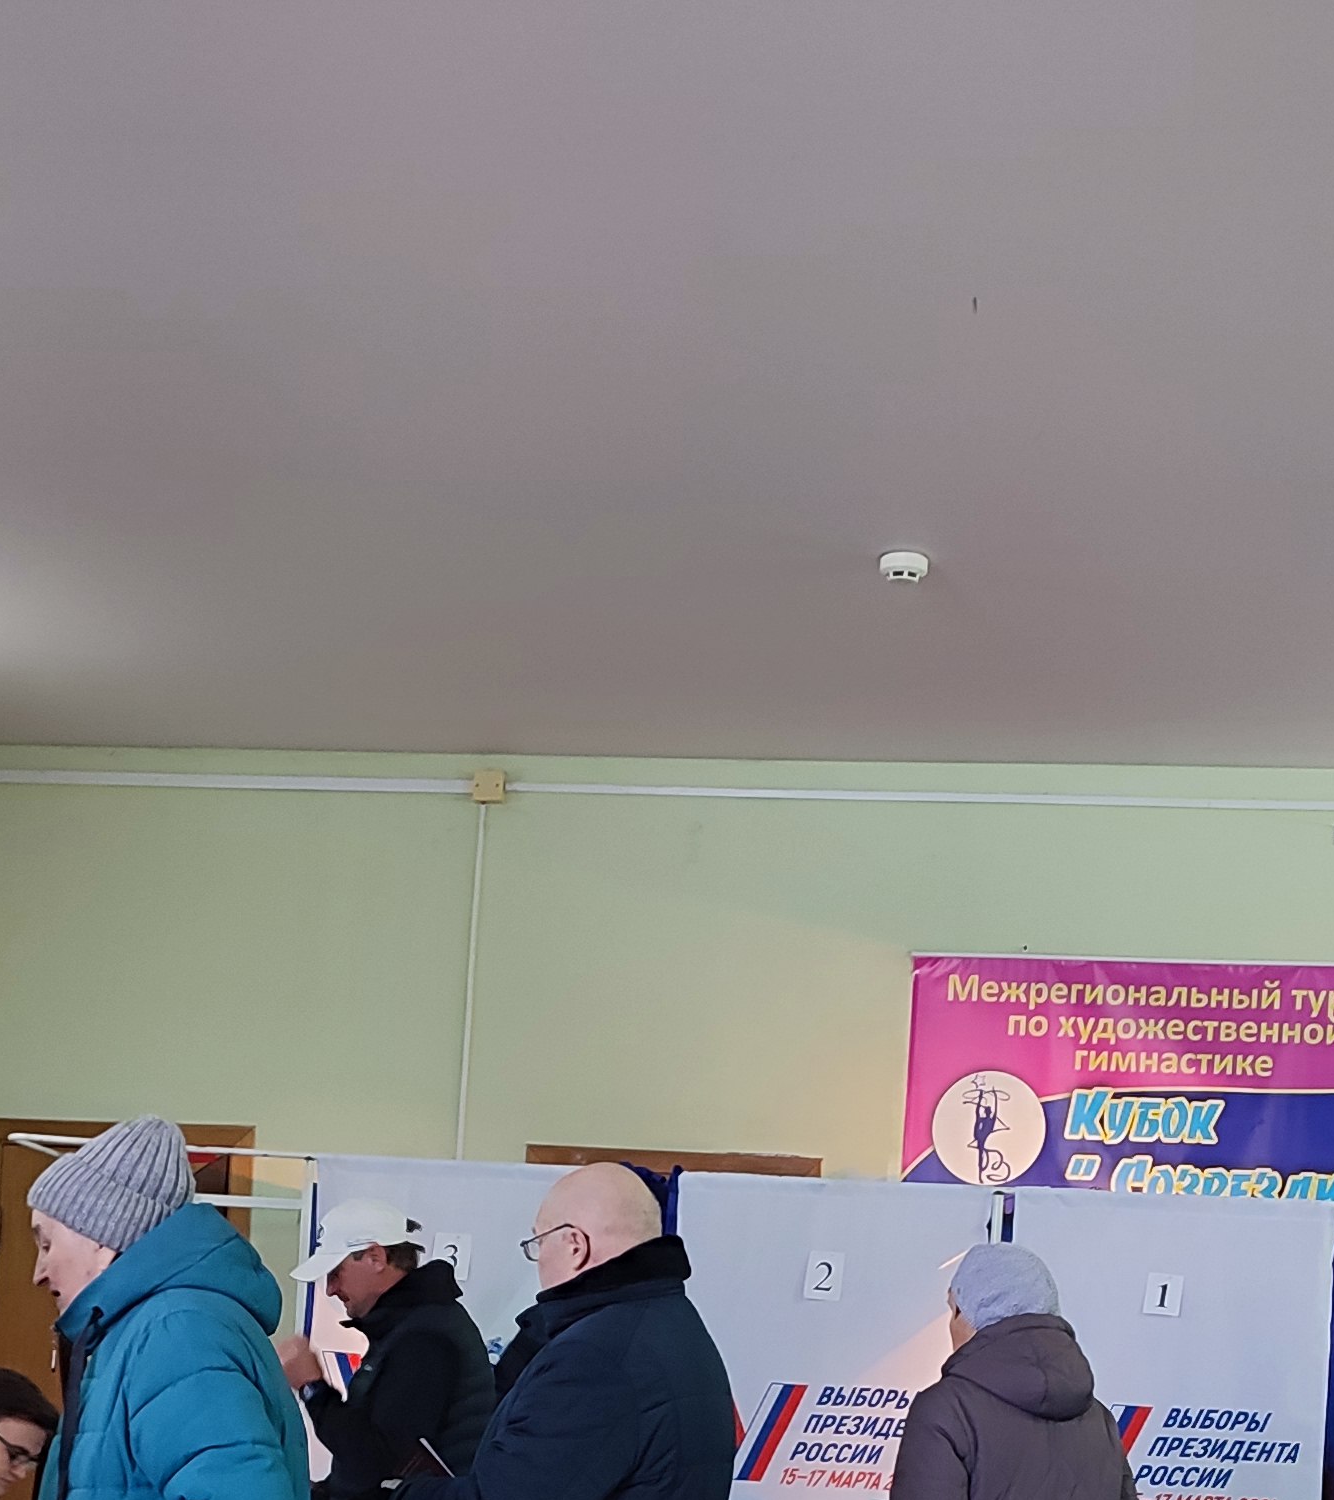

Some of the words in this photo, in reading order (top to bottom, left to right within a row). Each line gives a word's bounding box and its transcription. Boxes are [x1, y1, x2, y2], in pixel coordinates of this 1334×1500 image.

[946, 972, 1282, 1011] Межрегиональный
[1007, 1012, 1049, 1038] по
[1073, 1047, 1274, 1079] гимнастике
[812, 1260, 833, 1292] 2
[1156, 1283, 1170, 1309] 1
[803, 1413, 907, 1441] ПРЕЗИДЕ
[1162, 1407, 1272, 1433] ВЫБОРЫ
[789, 1441, 884, 1465] РОССИИ
[1147, 1436, 1301, 1464] ПРЕЗИДЕНТА
[825, 1470, 883, 1491] МАРТА
[1133, 1464, 1234, 1489] РОССИИ
